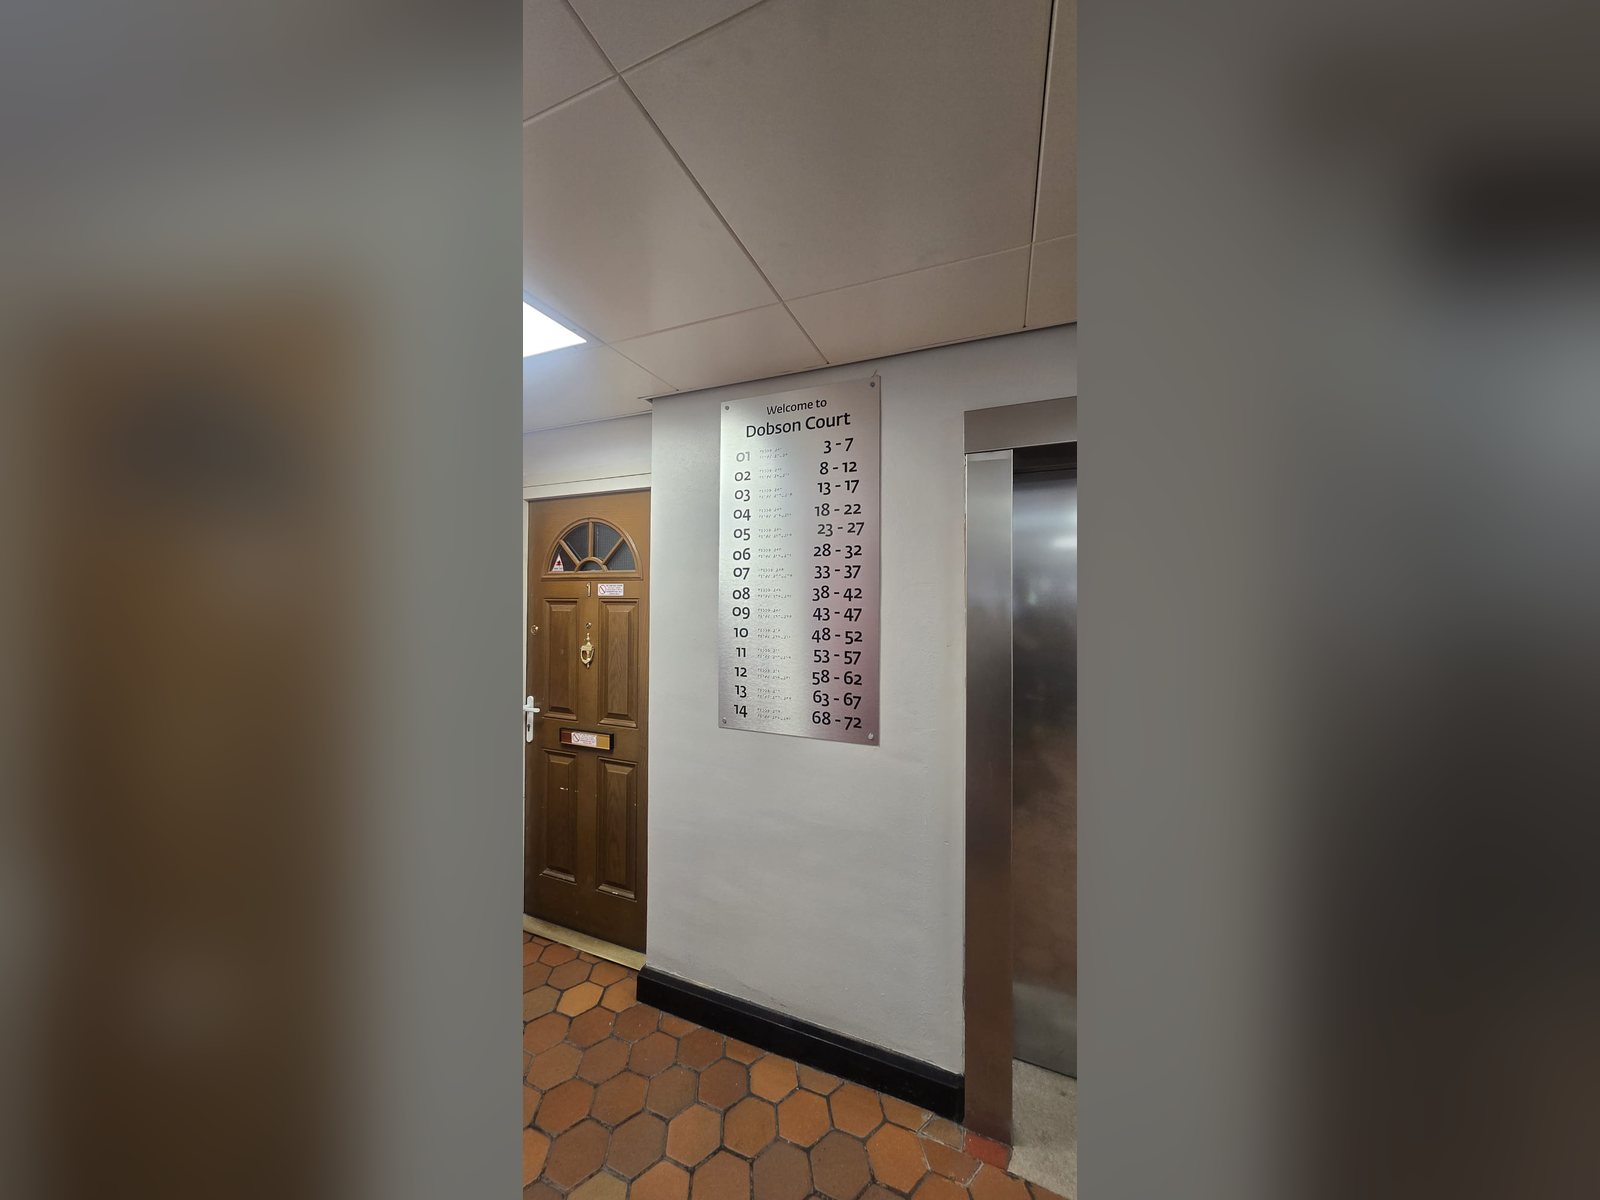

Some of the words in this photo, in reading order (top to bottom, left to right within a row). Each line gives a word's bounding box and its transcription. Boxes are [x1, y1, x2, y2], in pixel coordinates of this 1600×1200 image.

[766, 401, 814, 415] Welcome
[816, 398, 827, 408] to
[746, 420, 801, 438] Dobson
[805, 412, 851, 430] Court
[823, 440, 832, 454] 3
[844, 438, 854, 452] 7
[736, 451, 750, 462] 01
[820, 462, 828, 474] 8
[842, 462, 858, 472] 12
[734, 471, 751, 481] 02
[818, 482, 831, 495] 13
[844, 480, 859, 493] 17
[734, 489, 750, 502] 03
[733, 509, 751, 521] 04
[814, 503, 830, 516] 18
[844, 504, 861, 515] 22
[733, 528, 750, 541] 05
[817, 524, 833, 536] 23
[847, 522, 864, 535] 27
[733, 548, 750, 560] 06
[814, 544, 831, 557] 28
[844, 545, 862, 558] 32
[733, 567, 750, 580] 07
[814, 566, 831, 578] 33
[844, 565, 861, 578] 37
[586, 582, 591, 596] 1
[732, 587, 750, 600] 08
[812, 586, 830, 601] 38
[843, 588, 862, 601] 42
[732, 607, 750, 619] 09
[813, 607, 830, 621] 43
[844, 608, 862, 622] 47
[734, 628, 749, 638] 10
[812, 628, 831, 643] 48
[845, 631, 862, 644] 52
[736, 647, 746, 657] 11
[814, 649, 830, 663] 53
[844, 651, 861, 664] 57
[735, 667, 747, 677] 12
[812, 670, 830, 685] 58
[843, 671, 862, 686] 62
[735, 686, 747, 698] 13
[813, 690, 830, 706] 63
[843, 692, 861, 709] 67
[734, 704, 748, 718] 14
[812, 711, 831, 725] 68
[844, 716, 862, 730] 72
